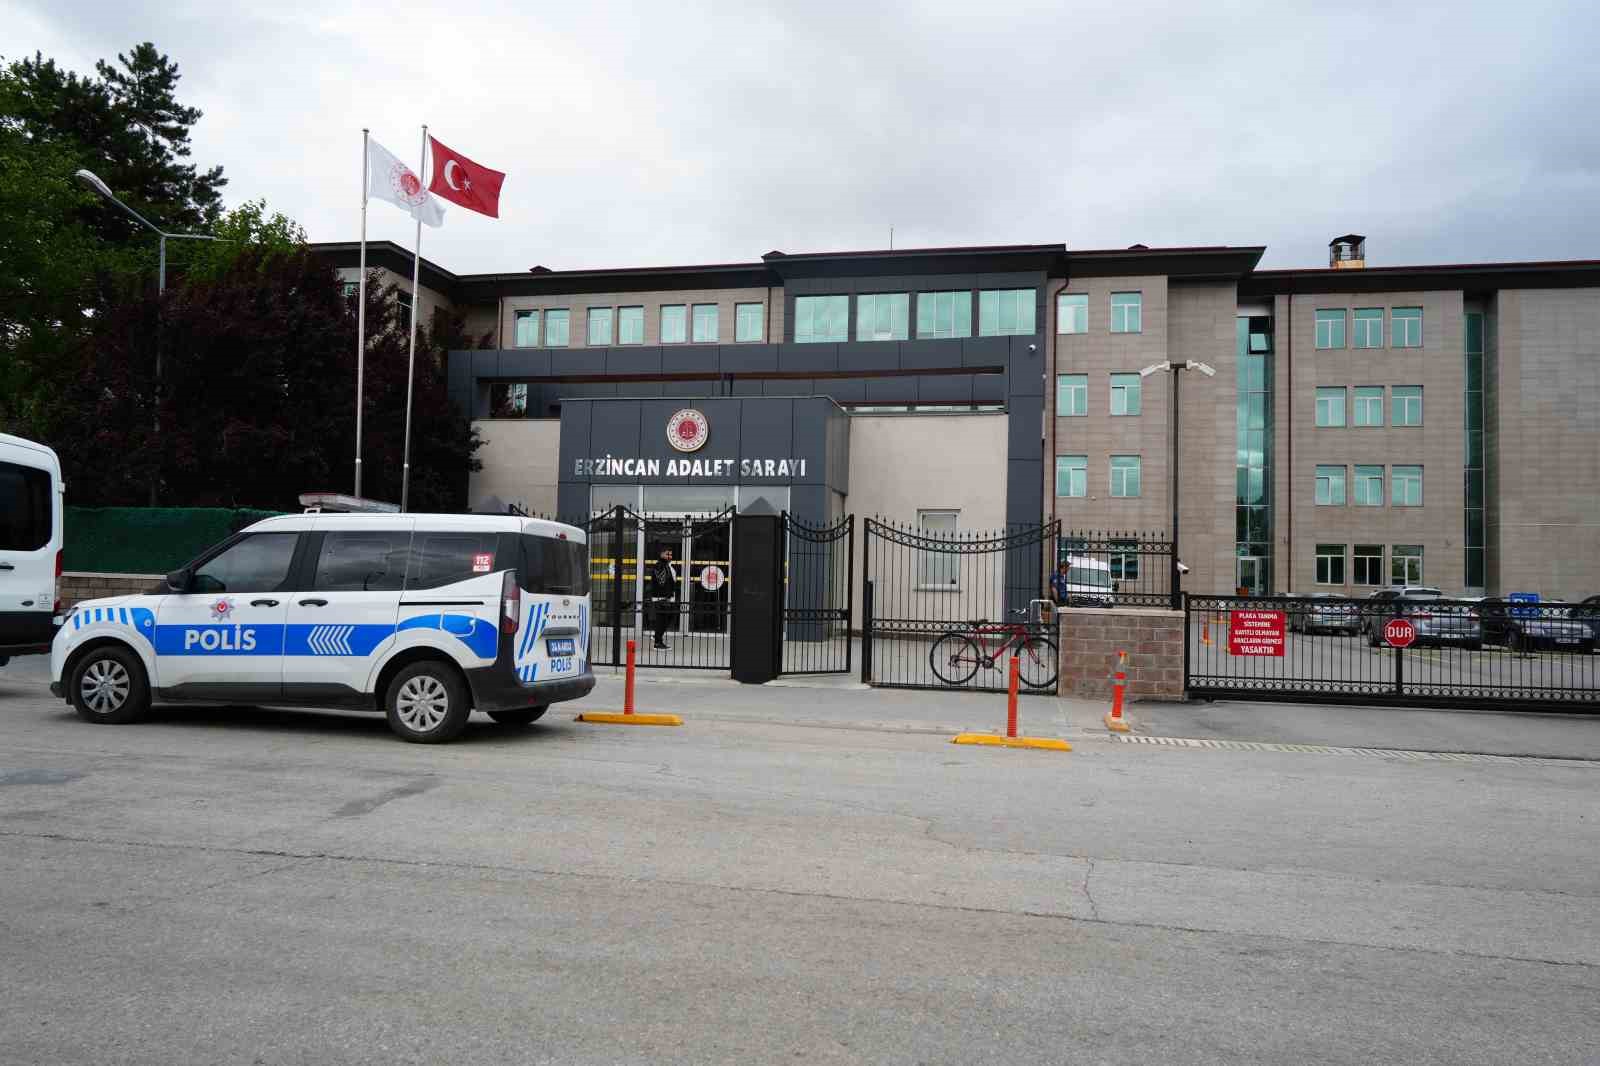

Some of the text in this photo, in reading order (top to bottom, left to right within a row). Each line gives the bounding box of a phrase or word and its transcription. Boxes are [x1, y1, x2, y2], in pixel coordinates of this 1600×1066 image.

[574, 454, 806, 477] ERZİNCAN ADALET SARAYI
[184, 624, 257, 651] POLİS
[1387, 626, 1412, 638] DUR
[1240, 645, 1274, 654] YASAKTIR
